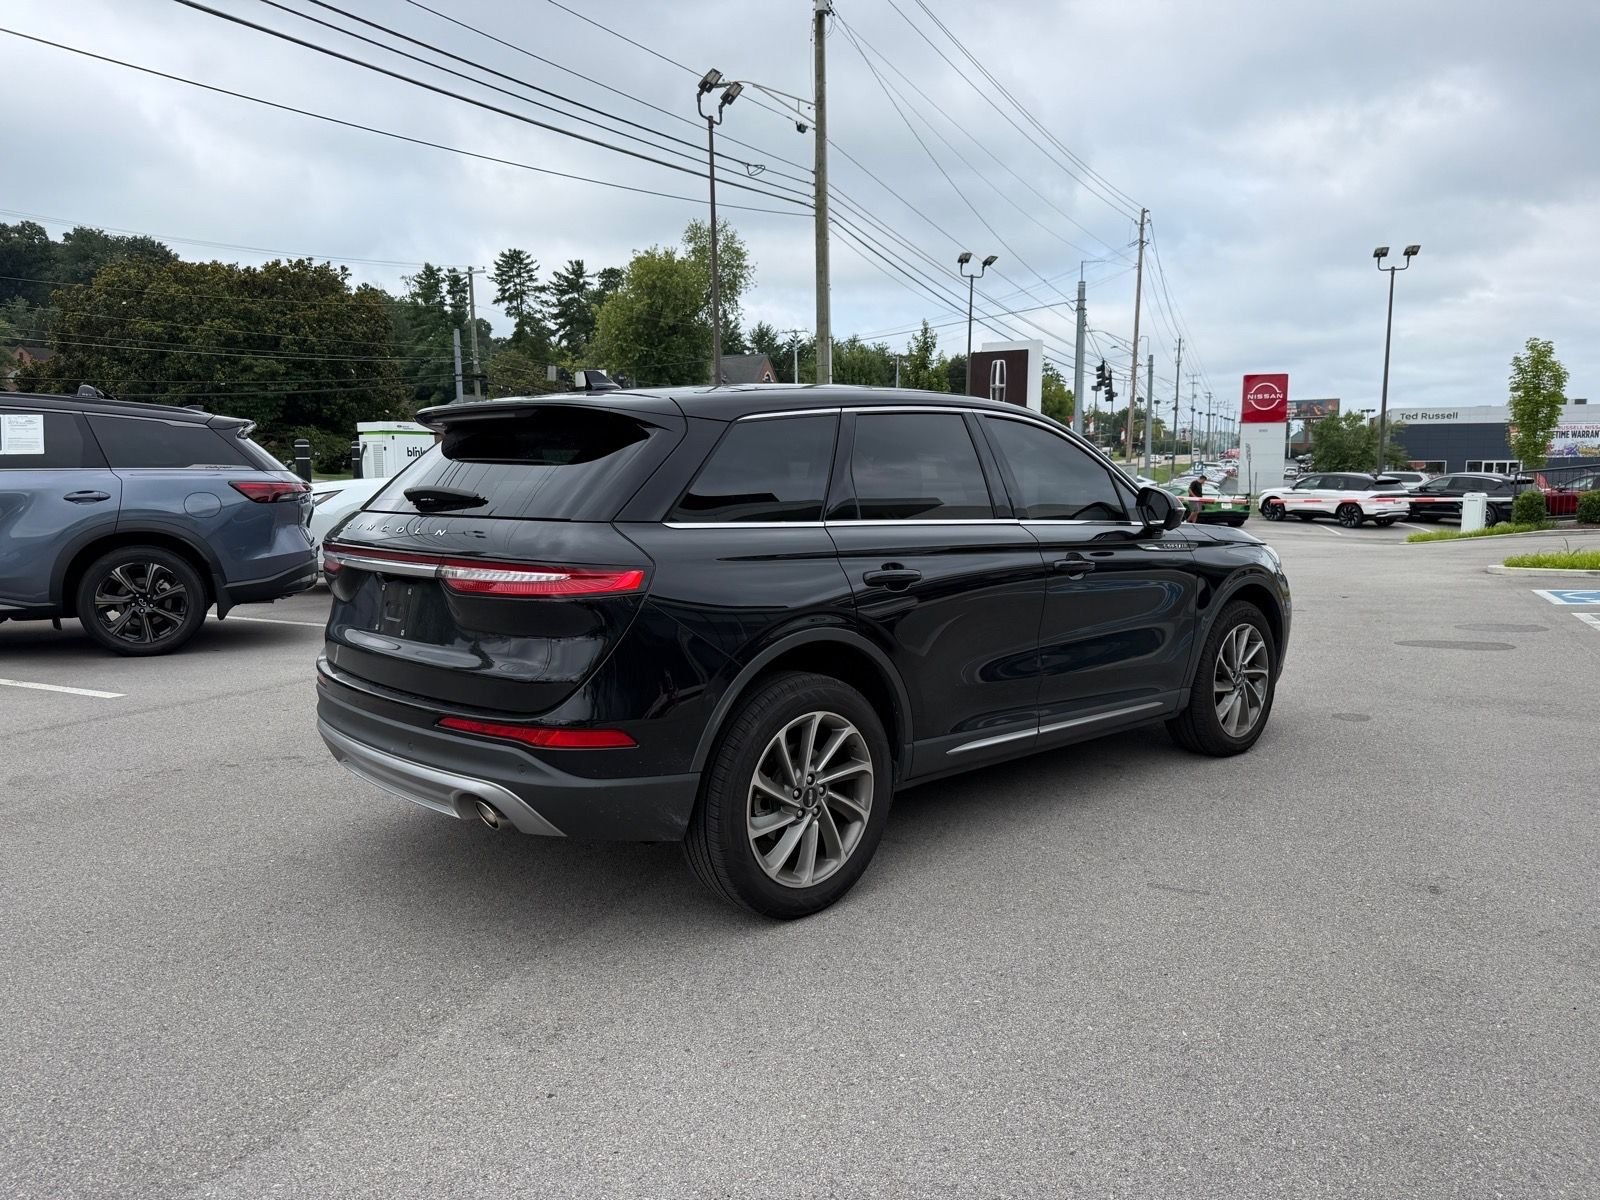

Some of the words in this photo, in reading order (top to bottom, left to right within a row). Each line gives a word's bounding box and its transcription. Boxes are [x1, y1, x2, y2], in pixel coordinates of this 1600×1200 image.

[1421, 412, 1458, 420] Russell
[1571, 430, 1600, 439] WARRAN
[347, 523, 446, 536] LINCOLN
